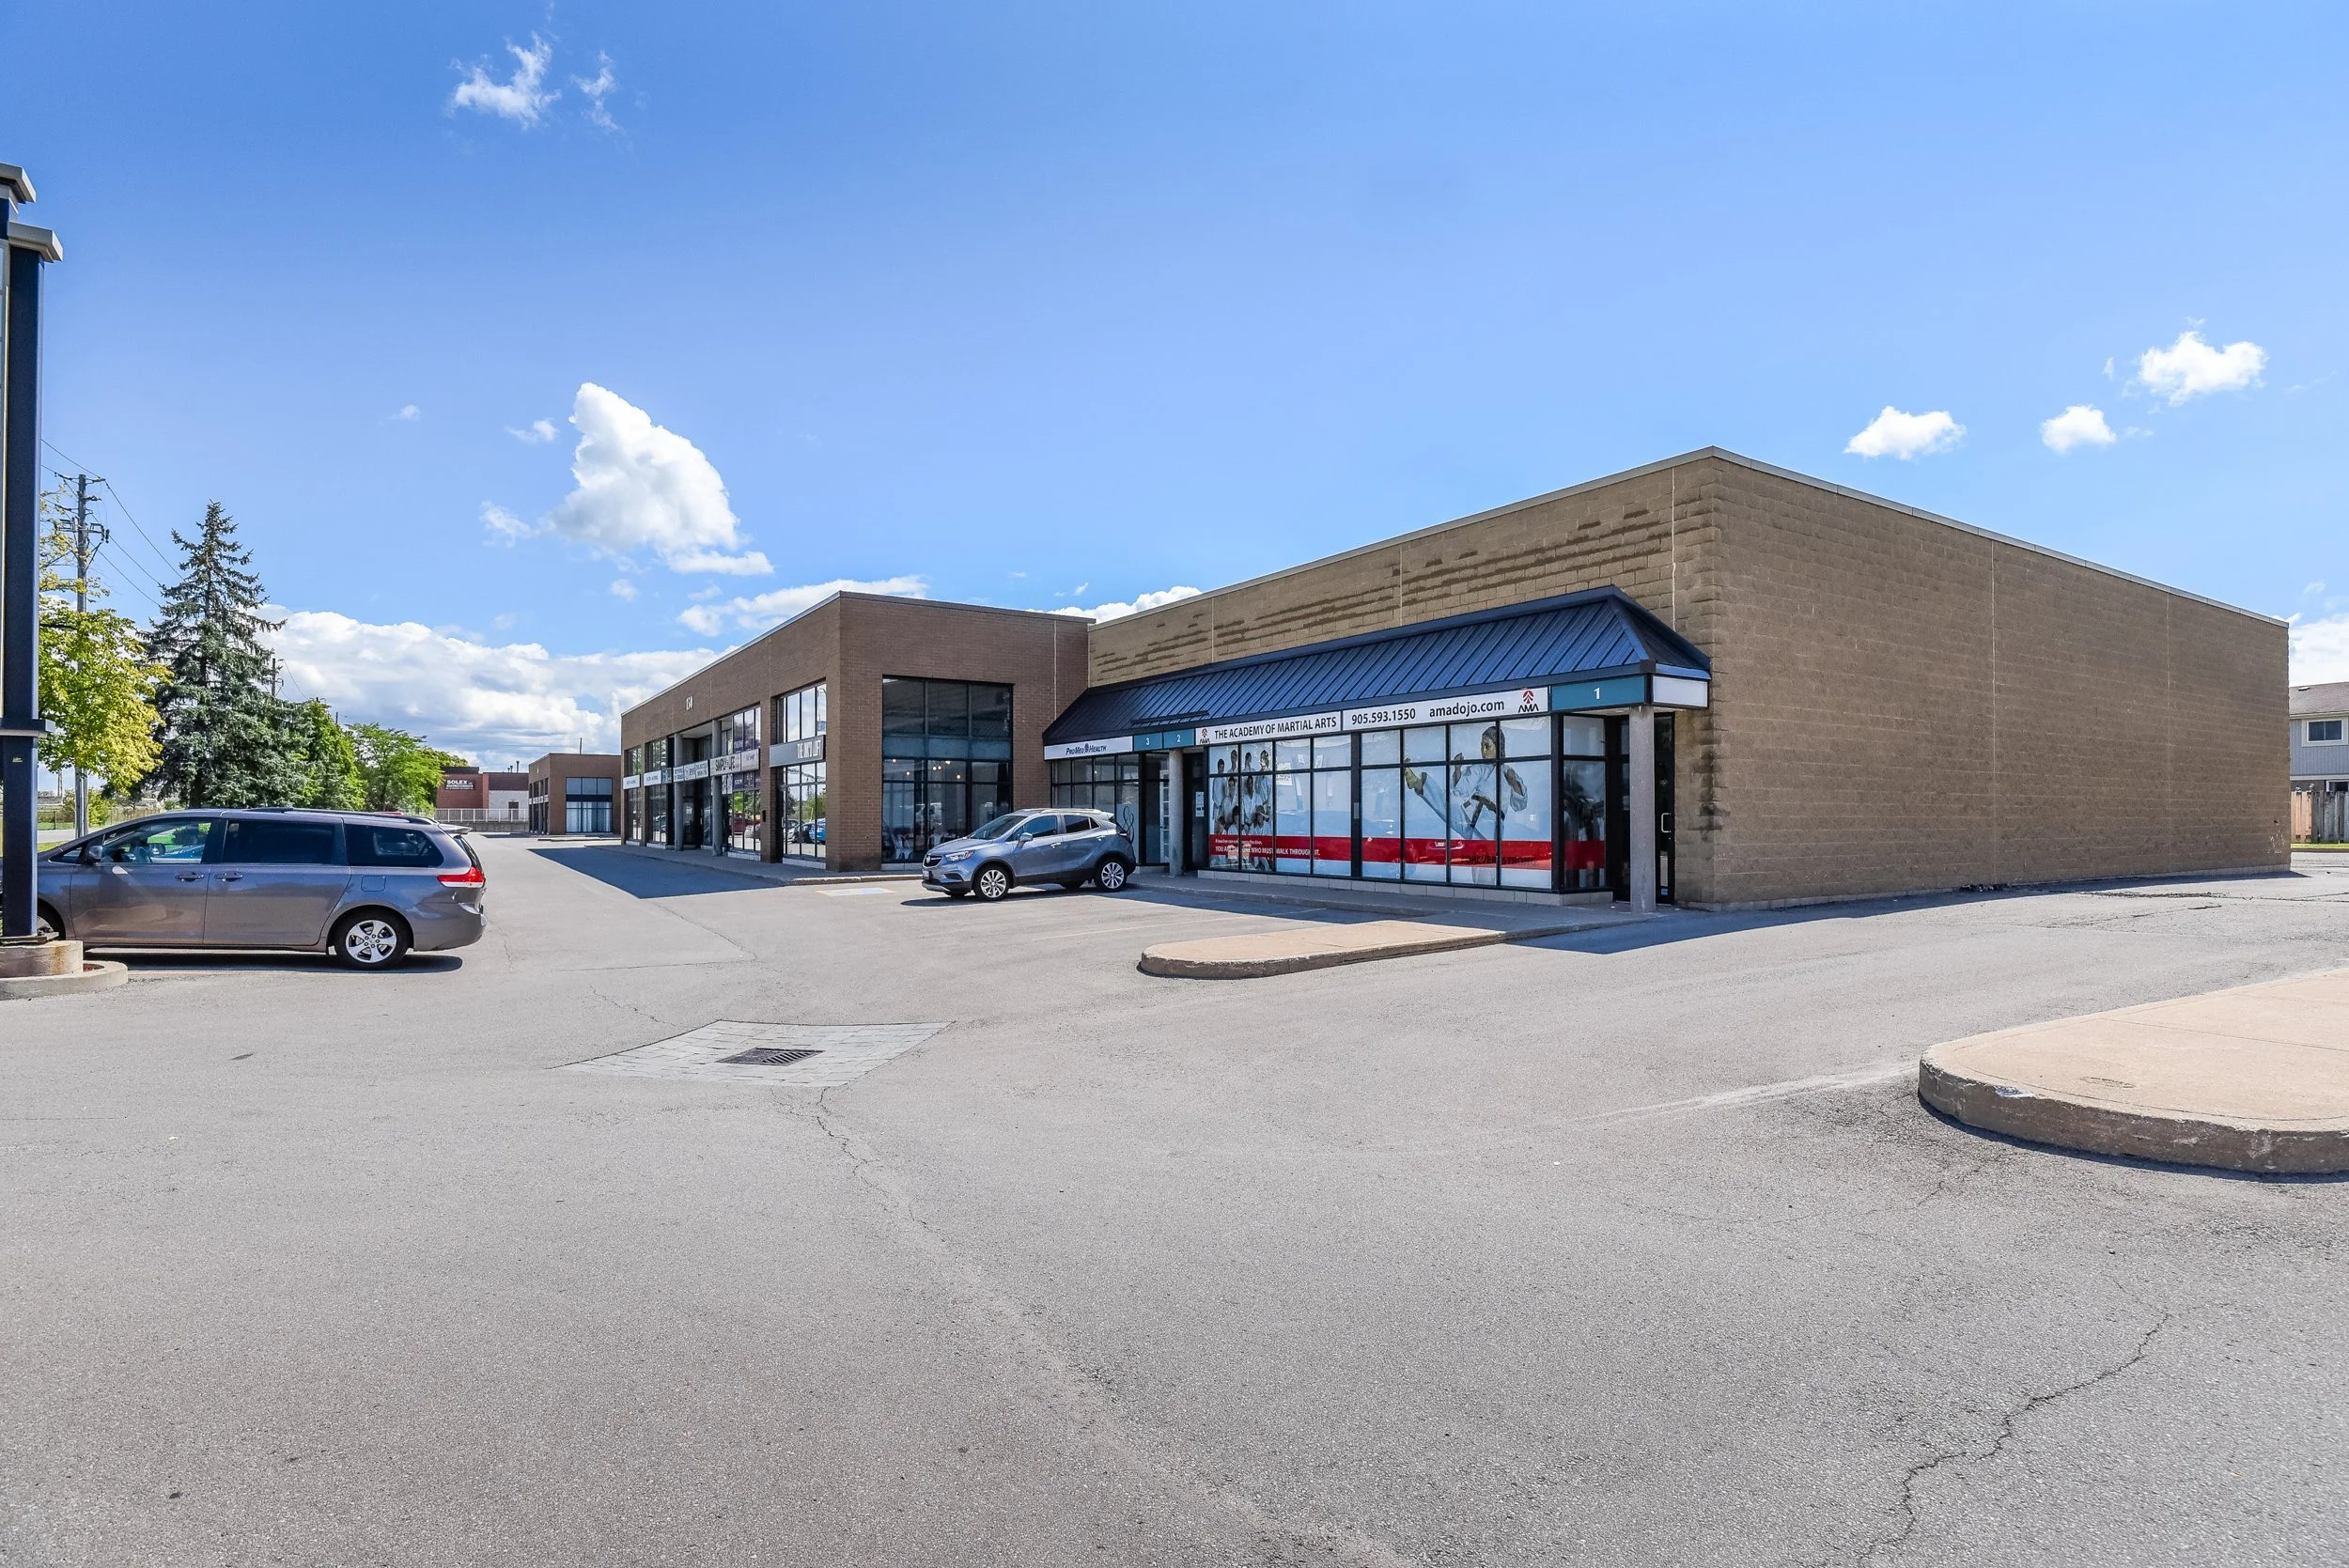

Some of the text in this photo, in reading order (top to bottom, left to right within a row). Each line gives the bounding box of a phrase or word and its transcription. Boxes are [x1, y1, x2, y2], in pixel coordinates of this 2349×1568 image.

[1594, 687, 1600, 700] 1
[1351, 700, 1505, 725] 905.593.1550 amadojo.com
[1517, 705, 1540, 714] AMA
[1214, 716, 1337, 740] THE ACADEMY OF MARTIAL ARTS
[1145, 737, 1150, 746] 3
[1176, 734, 1181, 743] 2
